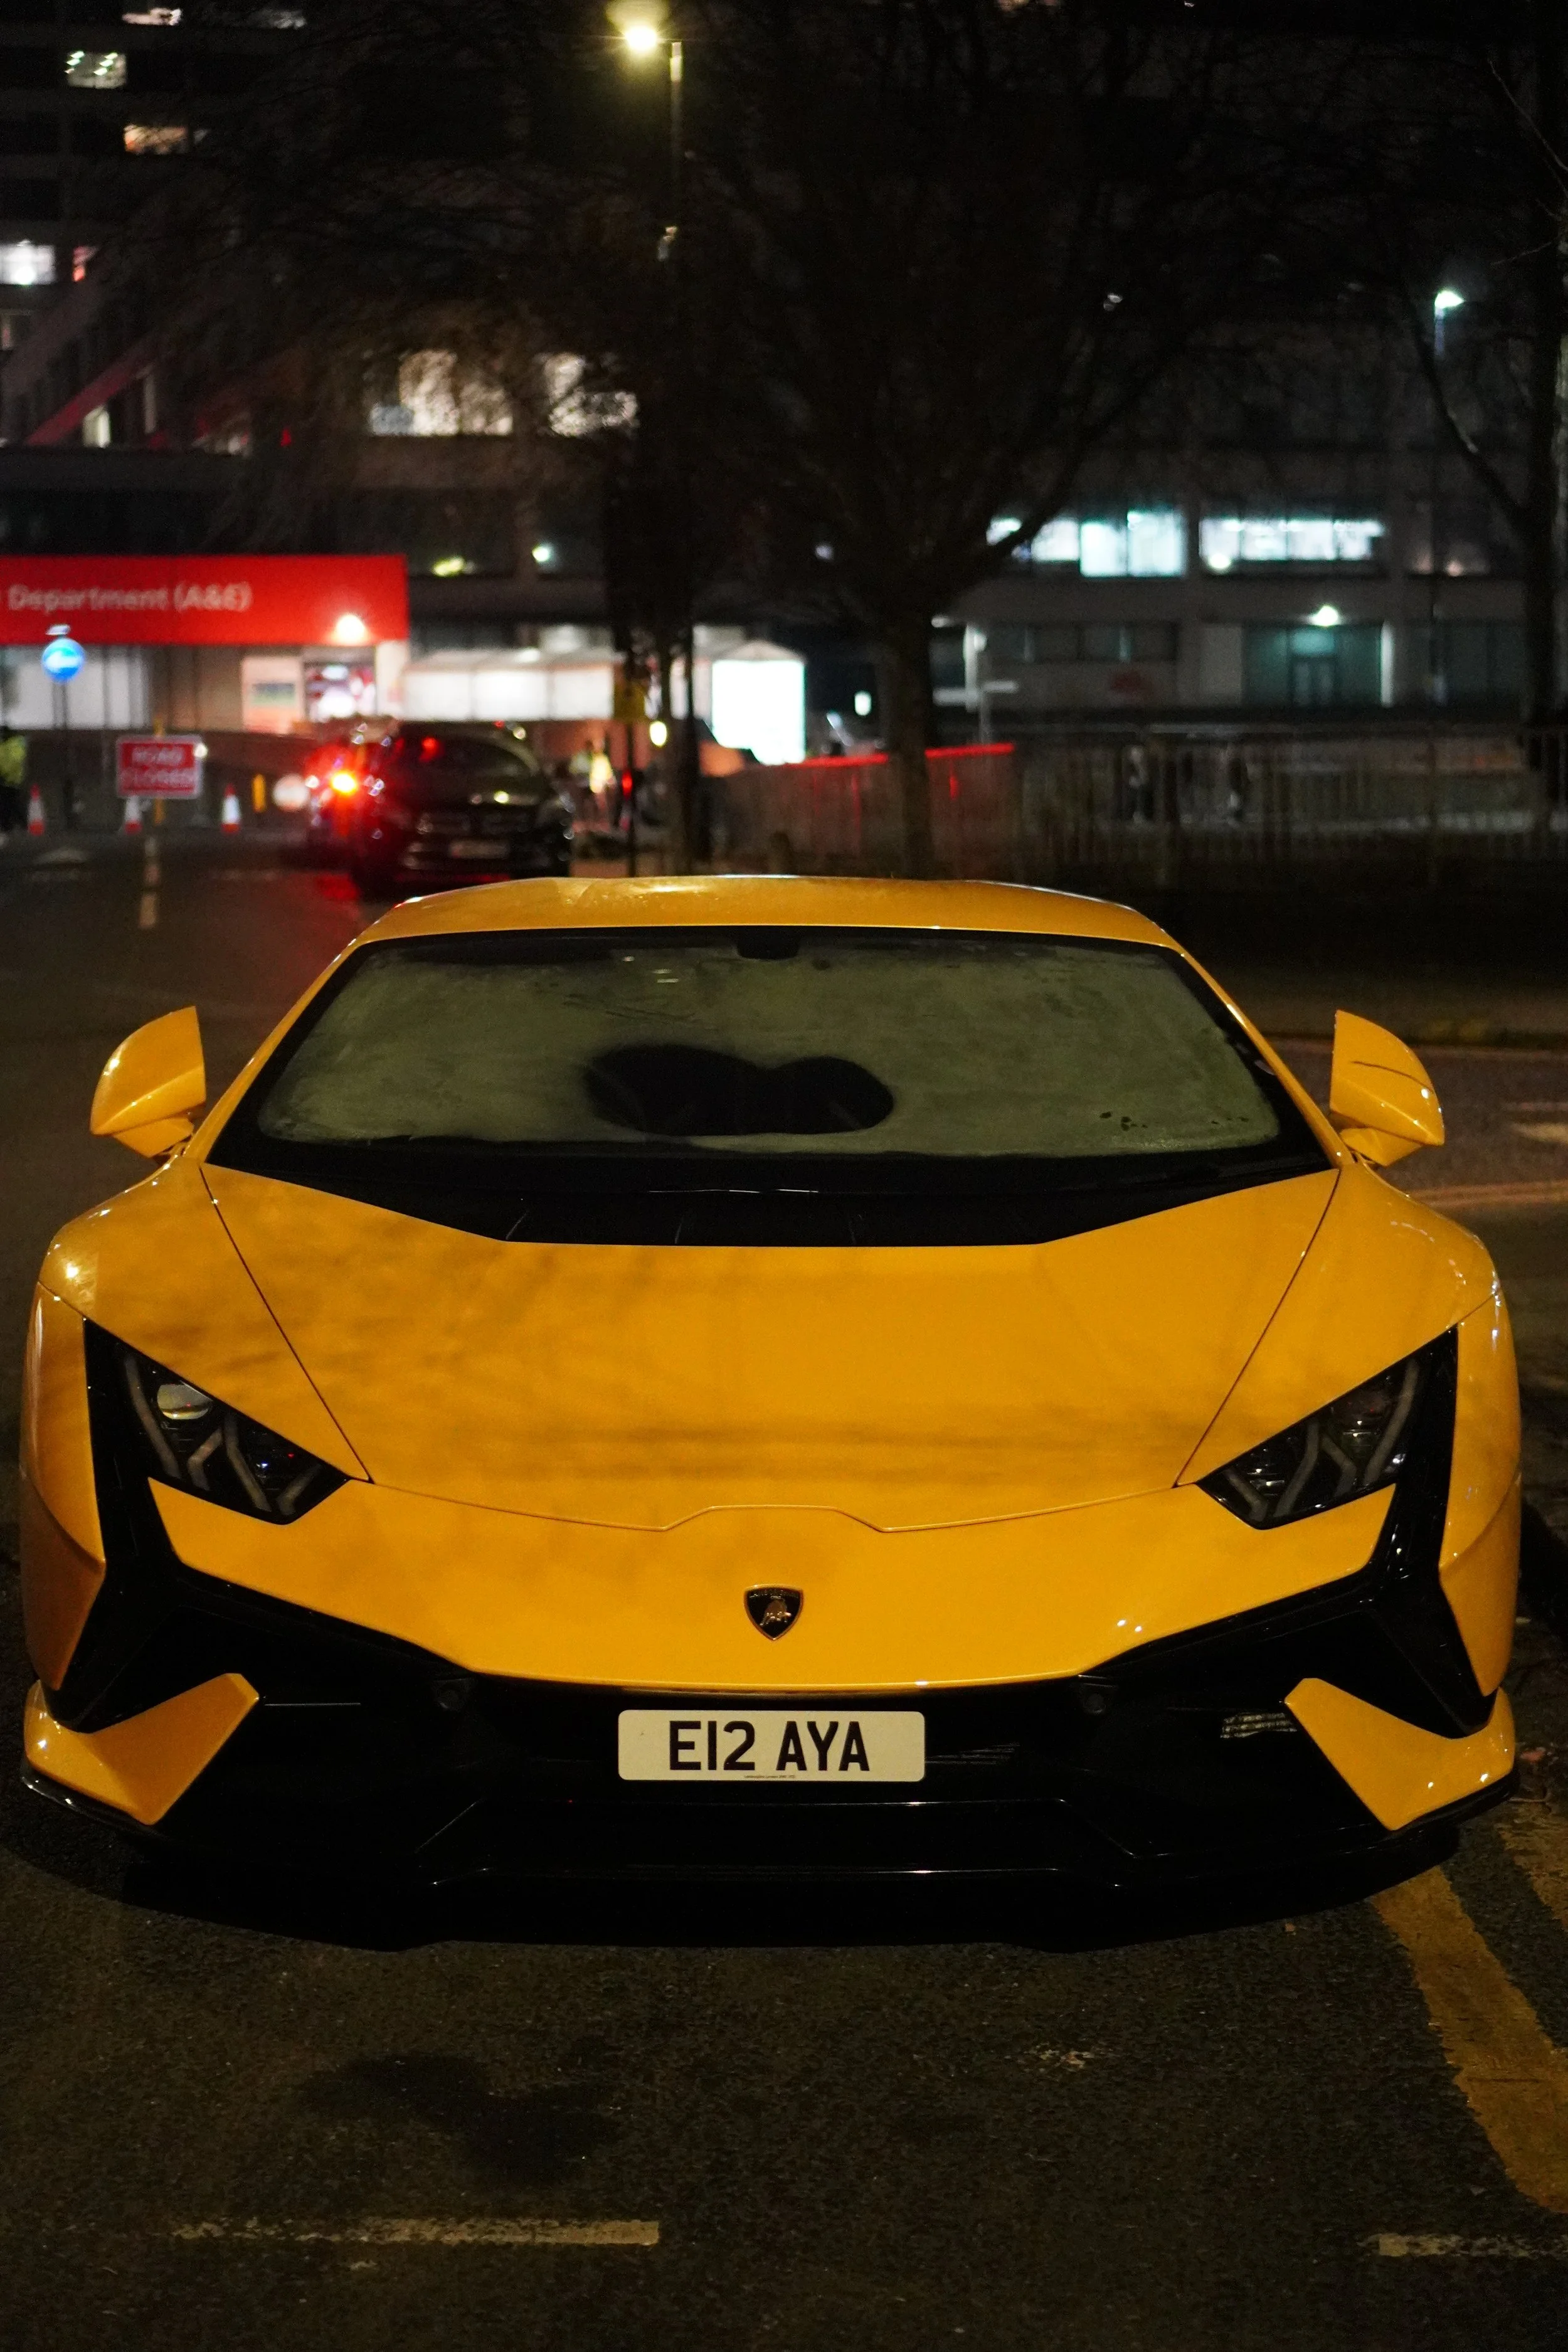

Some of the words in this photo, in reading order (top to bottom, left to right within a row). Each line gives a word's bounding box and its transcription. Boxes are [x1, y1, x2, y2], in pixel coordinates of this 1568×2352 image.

[8, 584, 169, 615] Department
[174, 581, 252, 613] (A&E)
[669, 1720, 756, 1771] E12
[775, 1720, 871, 1771] AYA
